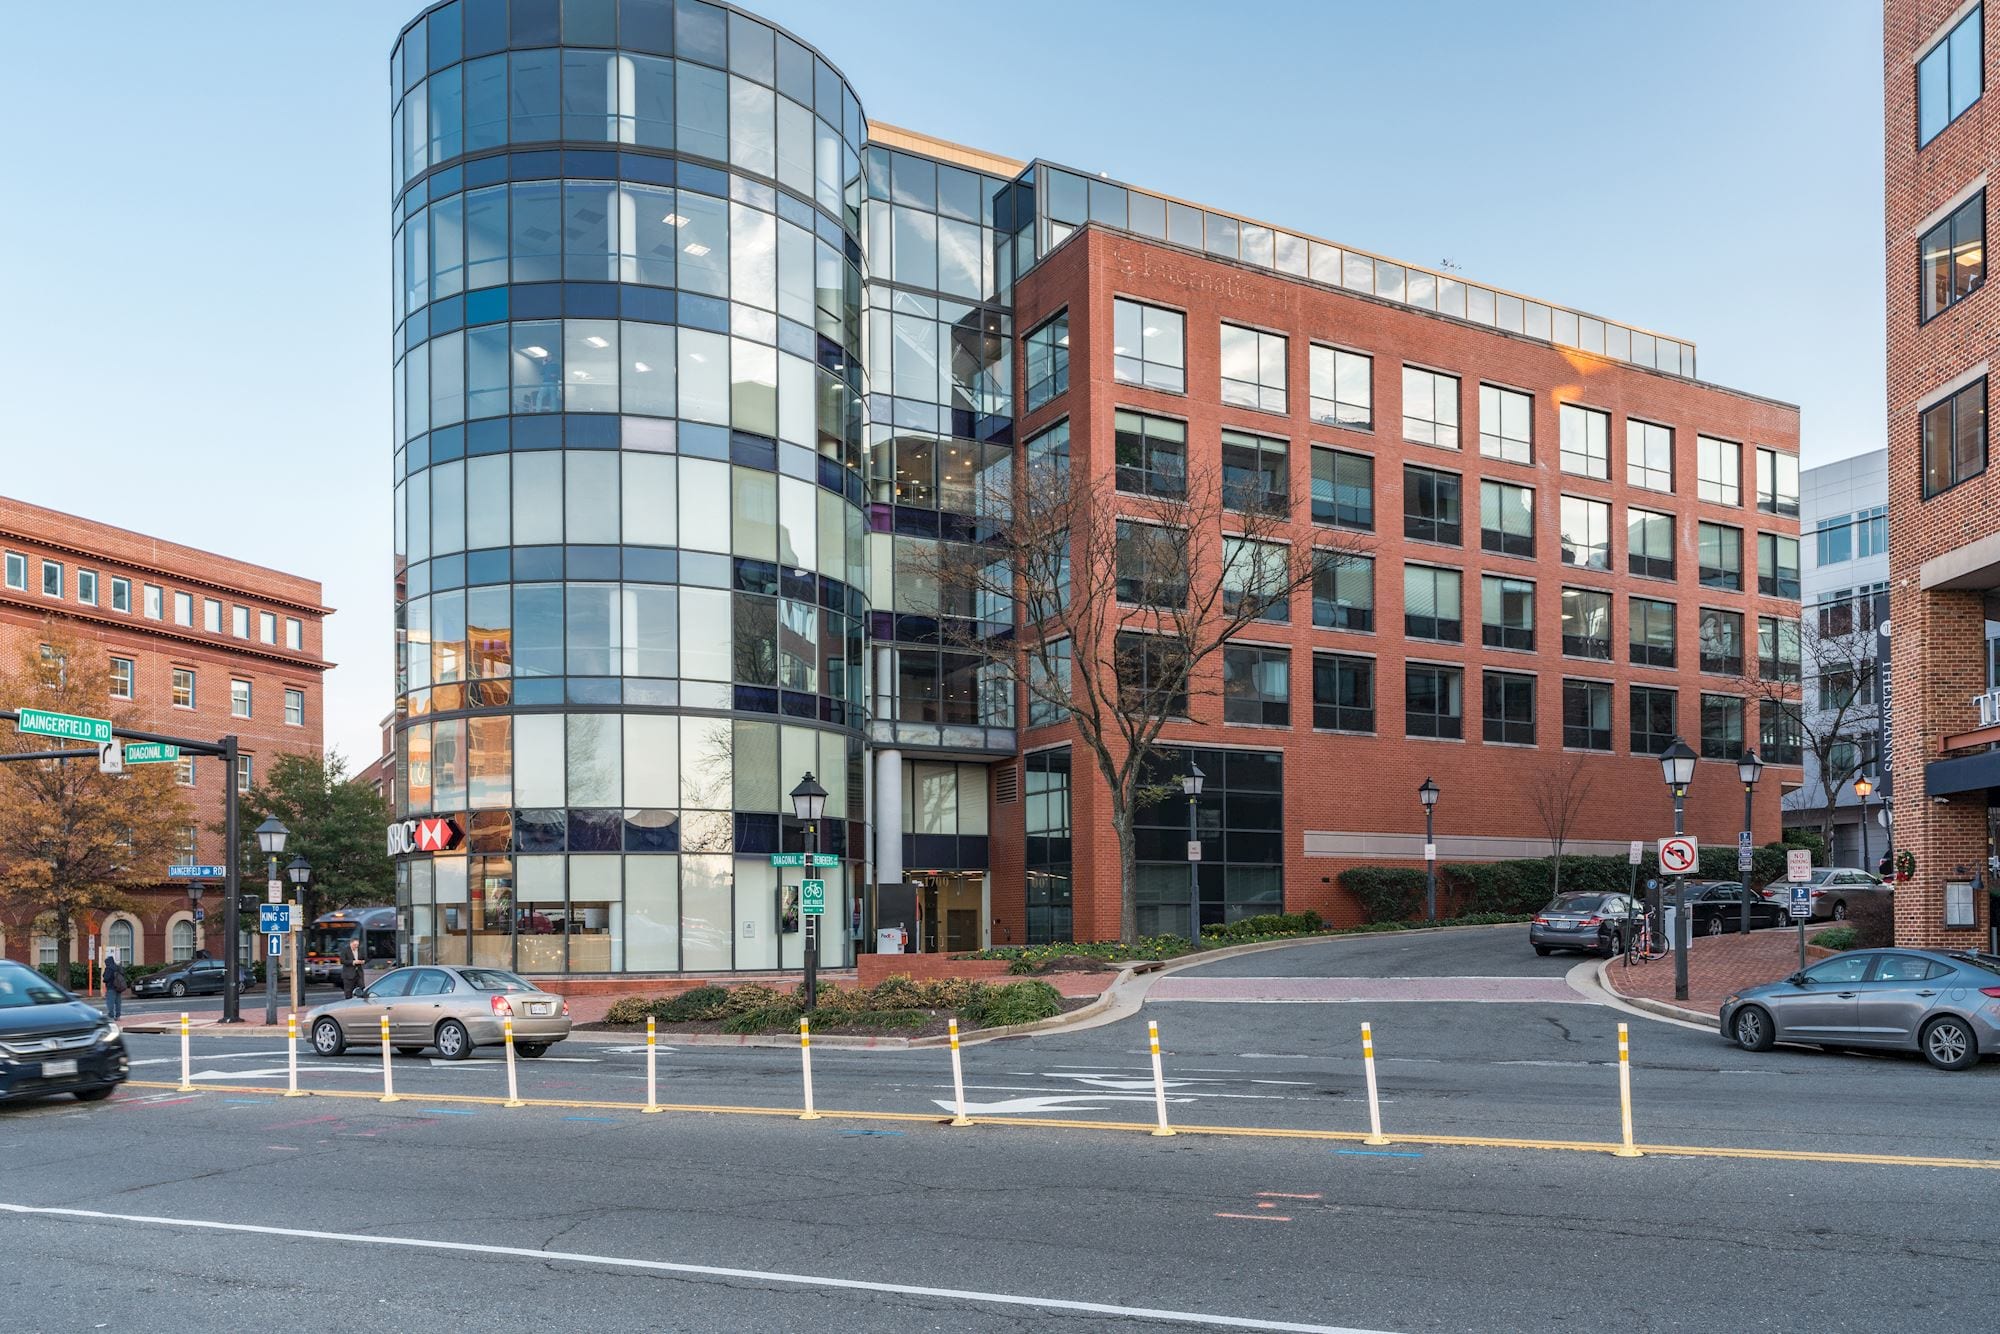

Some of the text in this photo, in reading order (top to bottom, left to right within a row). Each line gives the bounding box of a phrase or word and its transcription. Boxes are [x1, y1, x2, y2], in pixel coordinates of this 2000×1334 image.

[23, 713, 109, 739] DAINGERFIELD RD
[129, 746, 175, 759] DIAGONAL RD
[387, 820, 416, 857] SBC
[773, 855, 798, 864] DIAGONAL
[213, 866, 222, 876] RD
[1797, 889, 1804, 898] P
[261, 912, 277, 921] KING
[280, 912, 288, 921] ST
